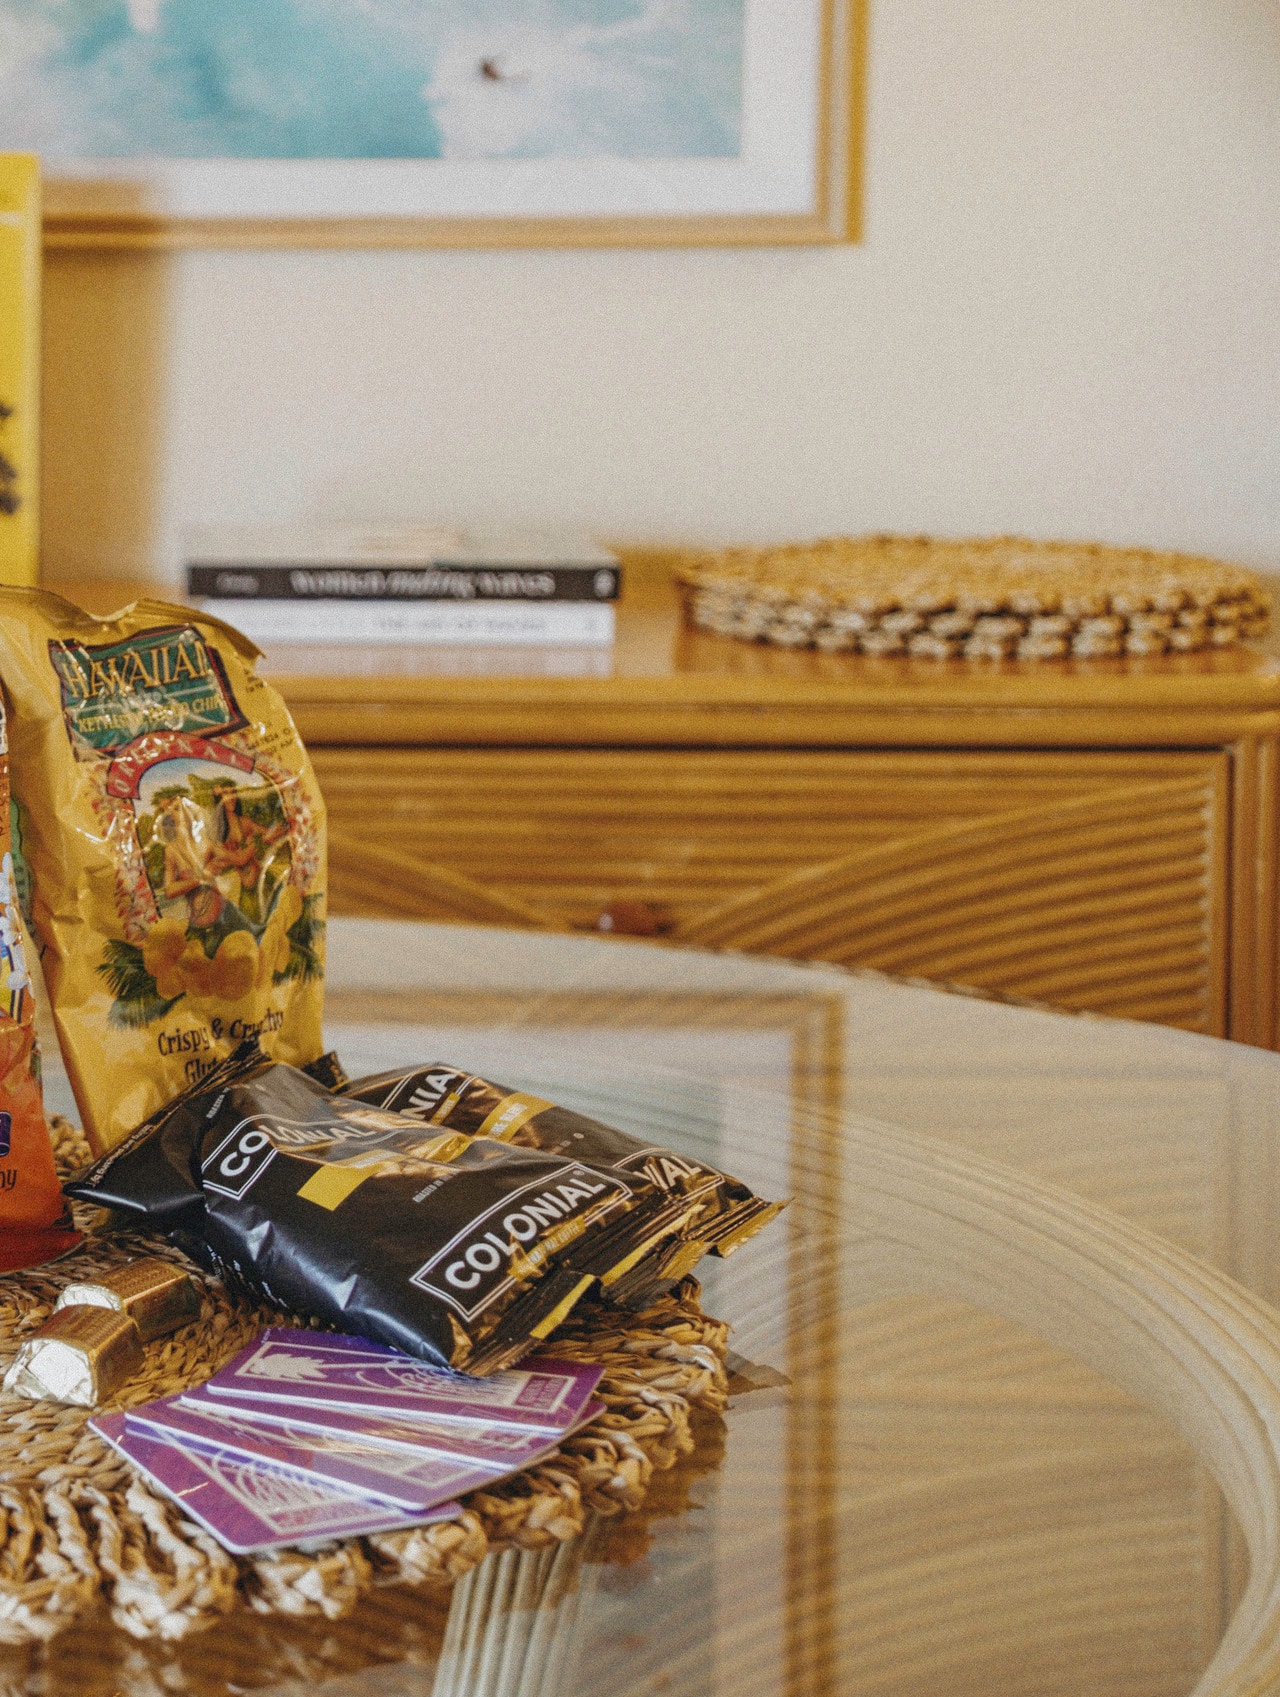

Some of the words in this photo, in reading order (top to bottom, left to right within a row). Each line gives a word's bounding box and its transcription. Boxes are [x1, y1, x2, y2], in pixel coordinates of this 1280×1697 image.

[159, 1028, 211, 1056] Crispy
[211, 1017, 223, 1040] &
[445, 1178, 607, 1290] COLONIAL
